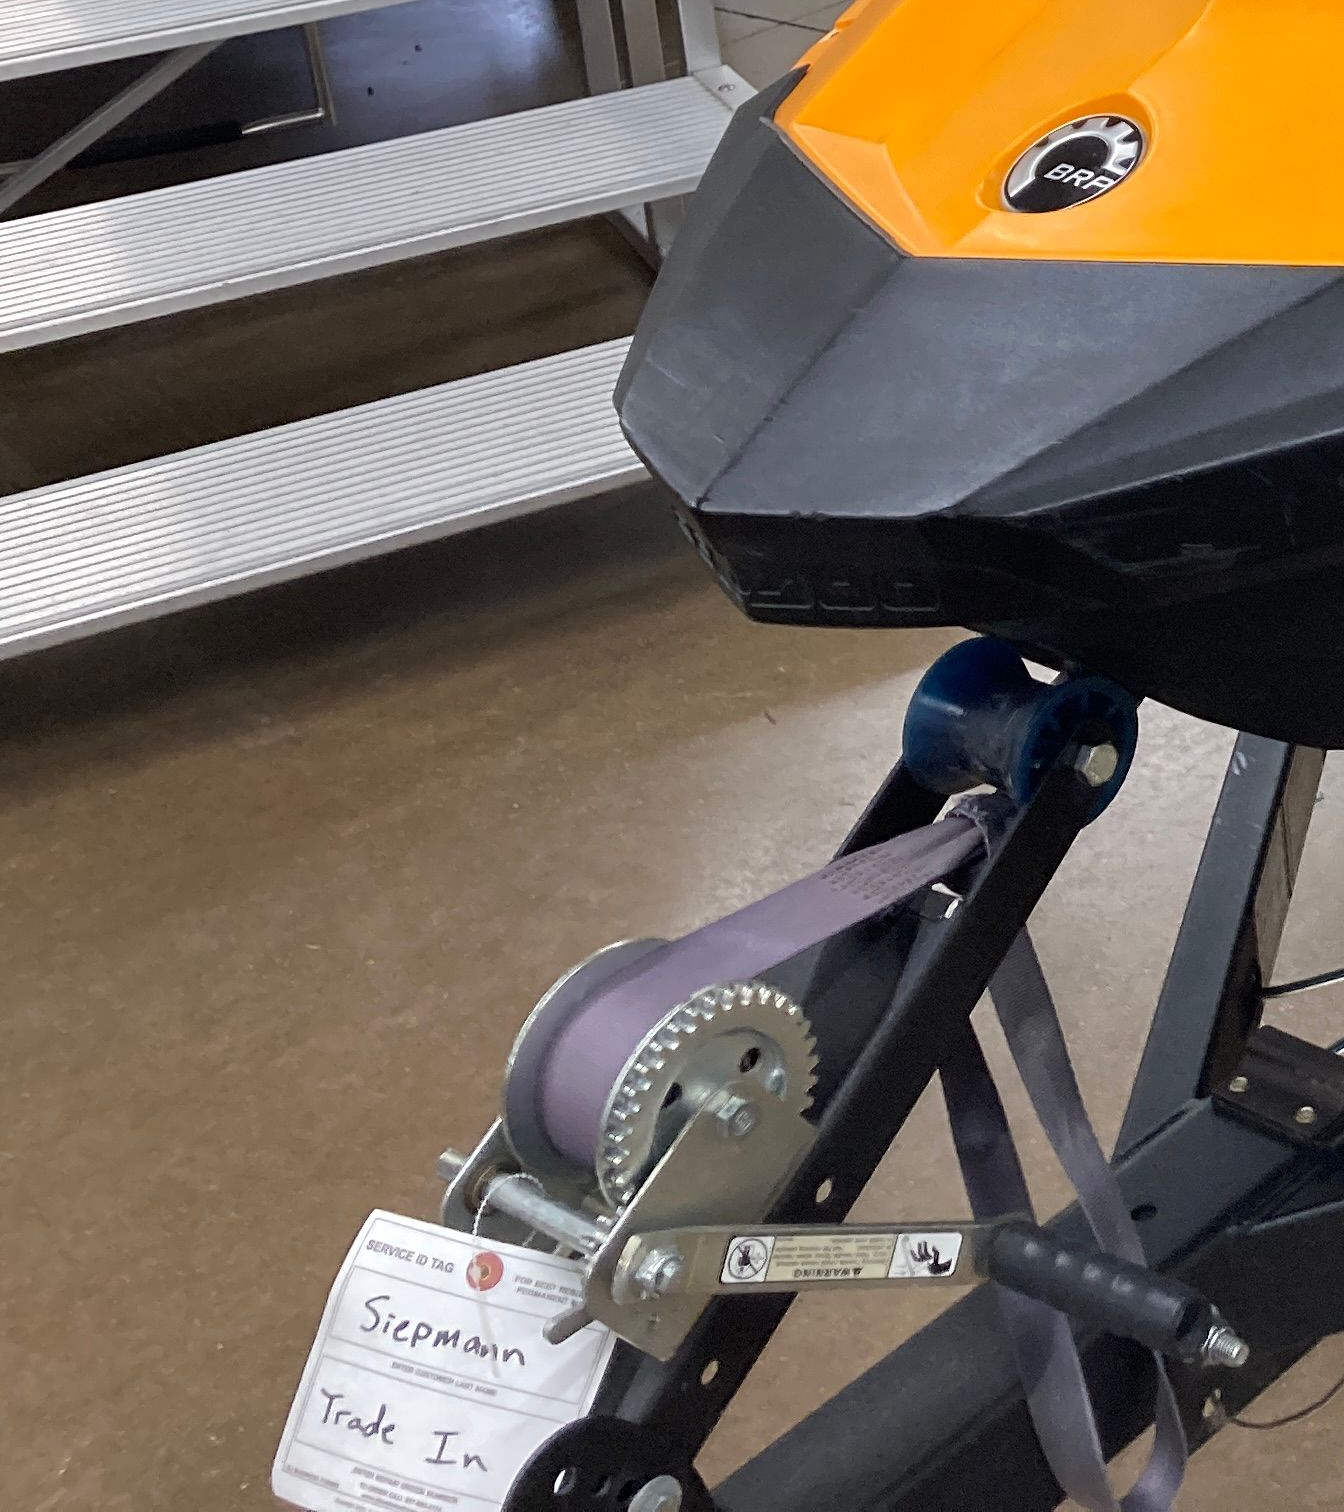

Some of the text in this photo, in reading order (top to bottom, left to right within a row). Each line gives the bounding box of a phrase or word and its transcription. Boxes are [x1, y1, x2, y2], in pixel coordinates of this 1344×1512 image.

[1043, 162, 1115, 190] BRP
[366, 1239, 455, 1274] SERVICE ID TAG
[360, 1295, 526, 1367] Siepmann
[321, 1387, 488, 1473] Trade In
